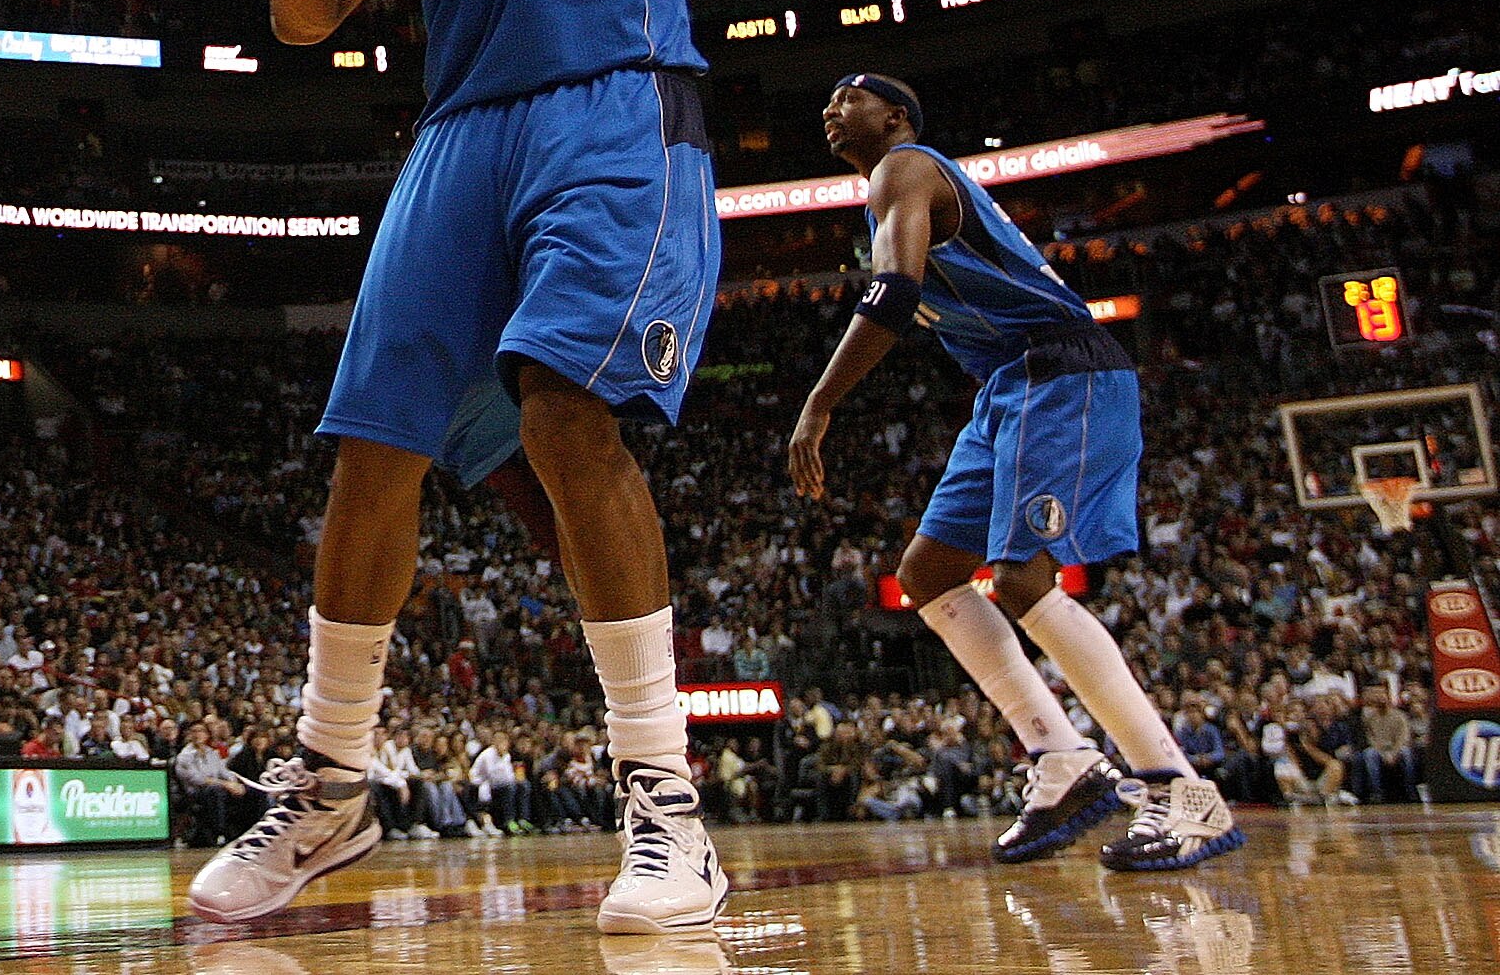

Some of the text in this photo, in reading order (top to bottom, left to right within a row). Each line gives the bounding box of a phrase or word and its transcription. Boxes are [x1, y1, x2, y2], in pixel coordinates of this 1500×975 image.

[997, 139, 1109, 177] for details.
[788, 188, 813, 207] or
[814, 179, 855, 203] call
[32, 206, 139, 232] WORLDWIDE
[139, 210, 286, 237] TRANSPORTATION
[287, 216, 360, 237] SERVICE
[861, 280, 887, 306] 31
[674, 688, 782, 717] OSHIBA
[60, 779, 161, 818] Presidente
